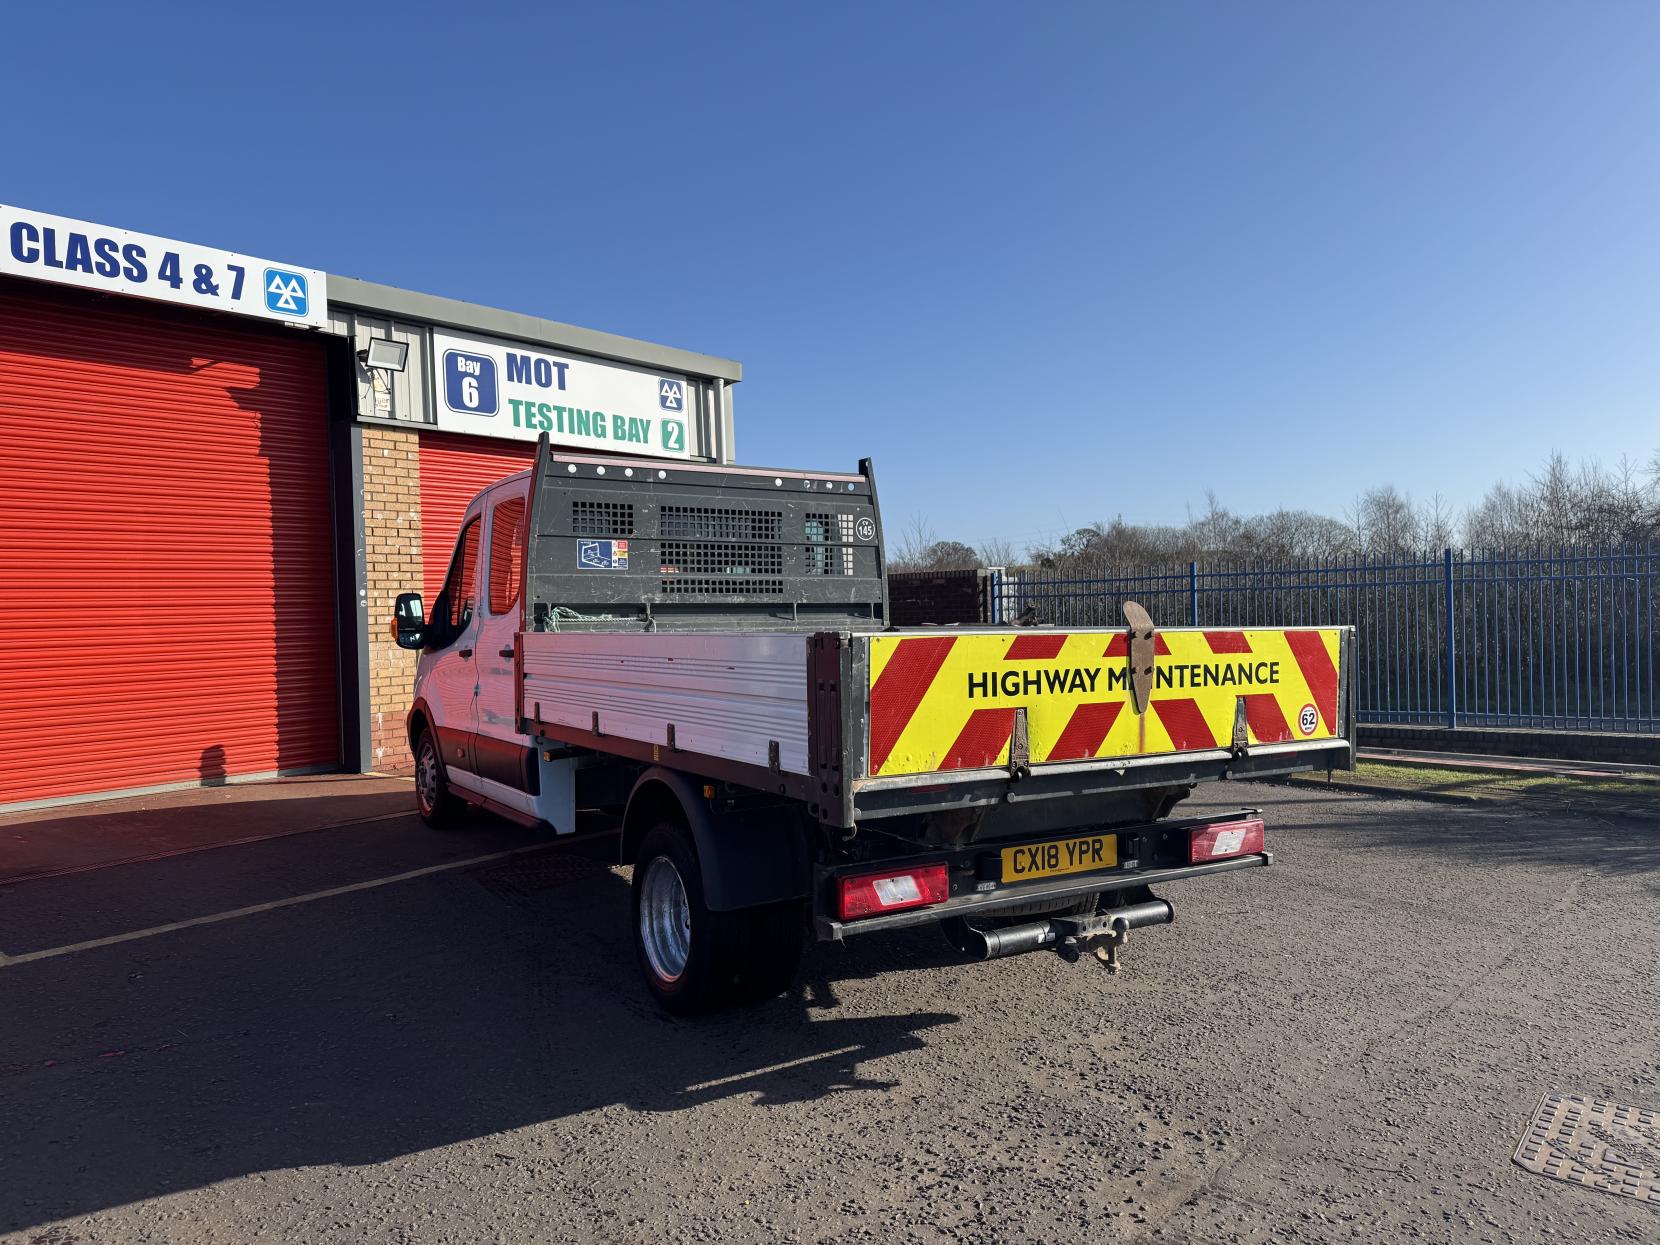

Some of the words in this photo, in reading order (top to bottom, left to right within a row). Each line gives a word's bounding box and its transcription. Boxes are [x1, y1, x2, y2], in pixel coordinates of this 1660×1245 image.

[10, 222, 148, 283] CLASS
[157, 251, 183, 290] 4
[192, 263, 220, 297] &
[226, 264, 246, 301] 7
[457, 357, 481, 376] Bay
[506, 352, 570, 391] MOT
[462, 376, 480, 409] 6
[508, 398, 607, 439] TESTING
[612, 414, 652, 444] BAY
[667, 422, 680, 449] 2
[858, 525, 872, 536] 145
[968, 668, 1102, 699] HIGHWAY
[1108, 662, 1280, 691] MNTENANCE
[1301, 712, 1316, 727] 62
[1013, 844, 1059, 874] CX18
[1065, 839, 1104, 867] YPR
